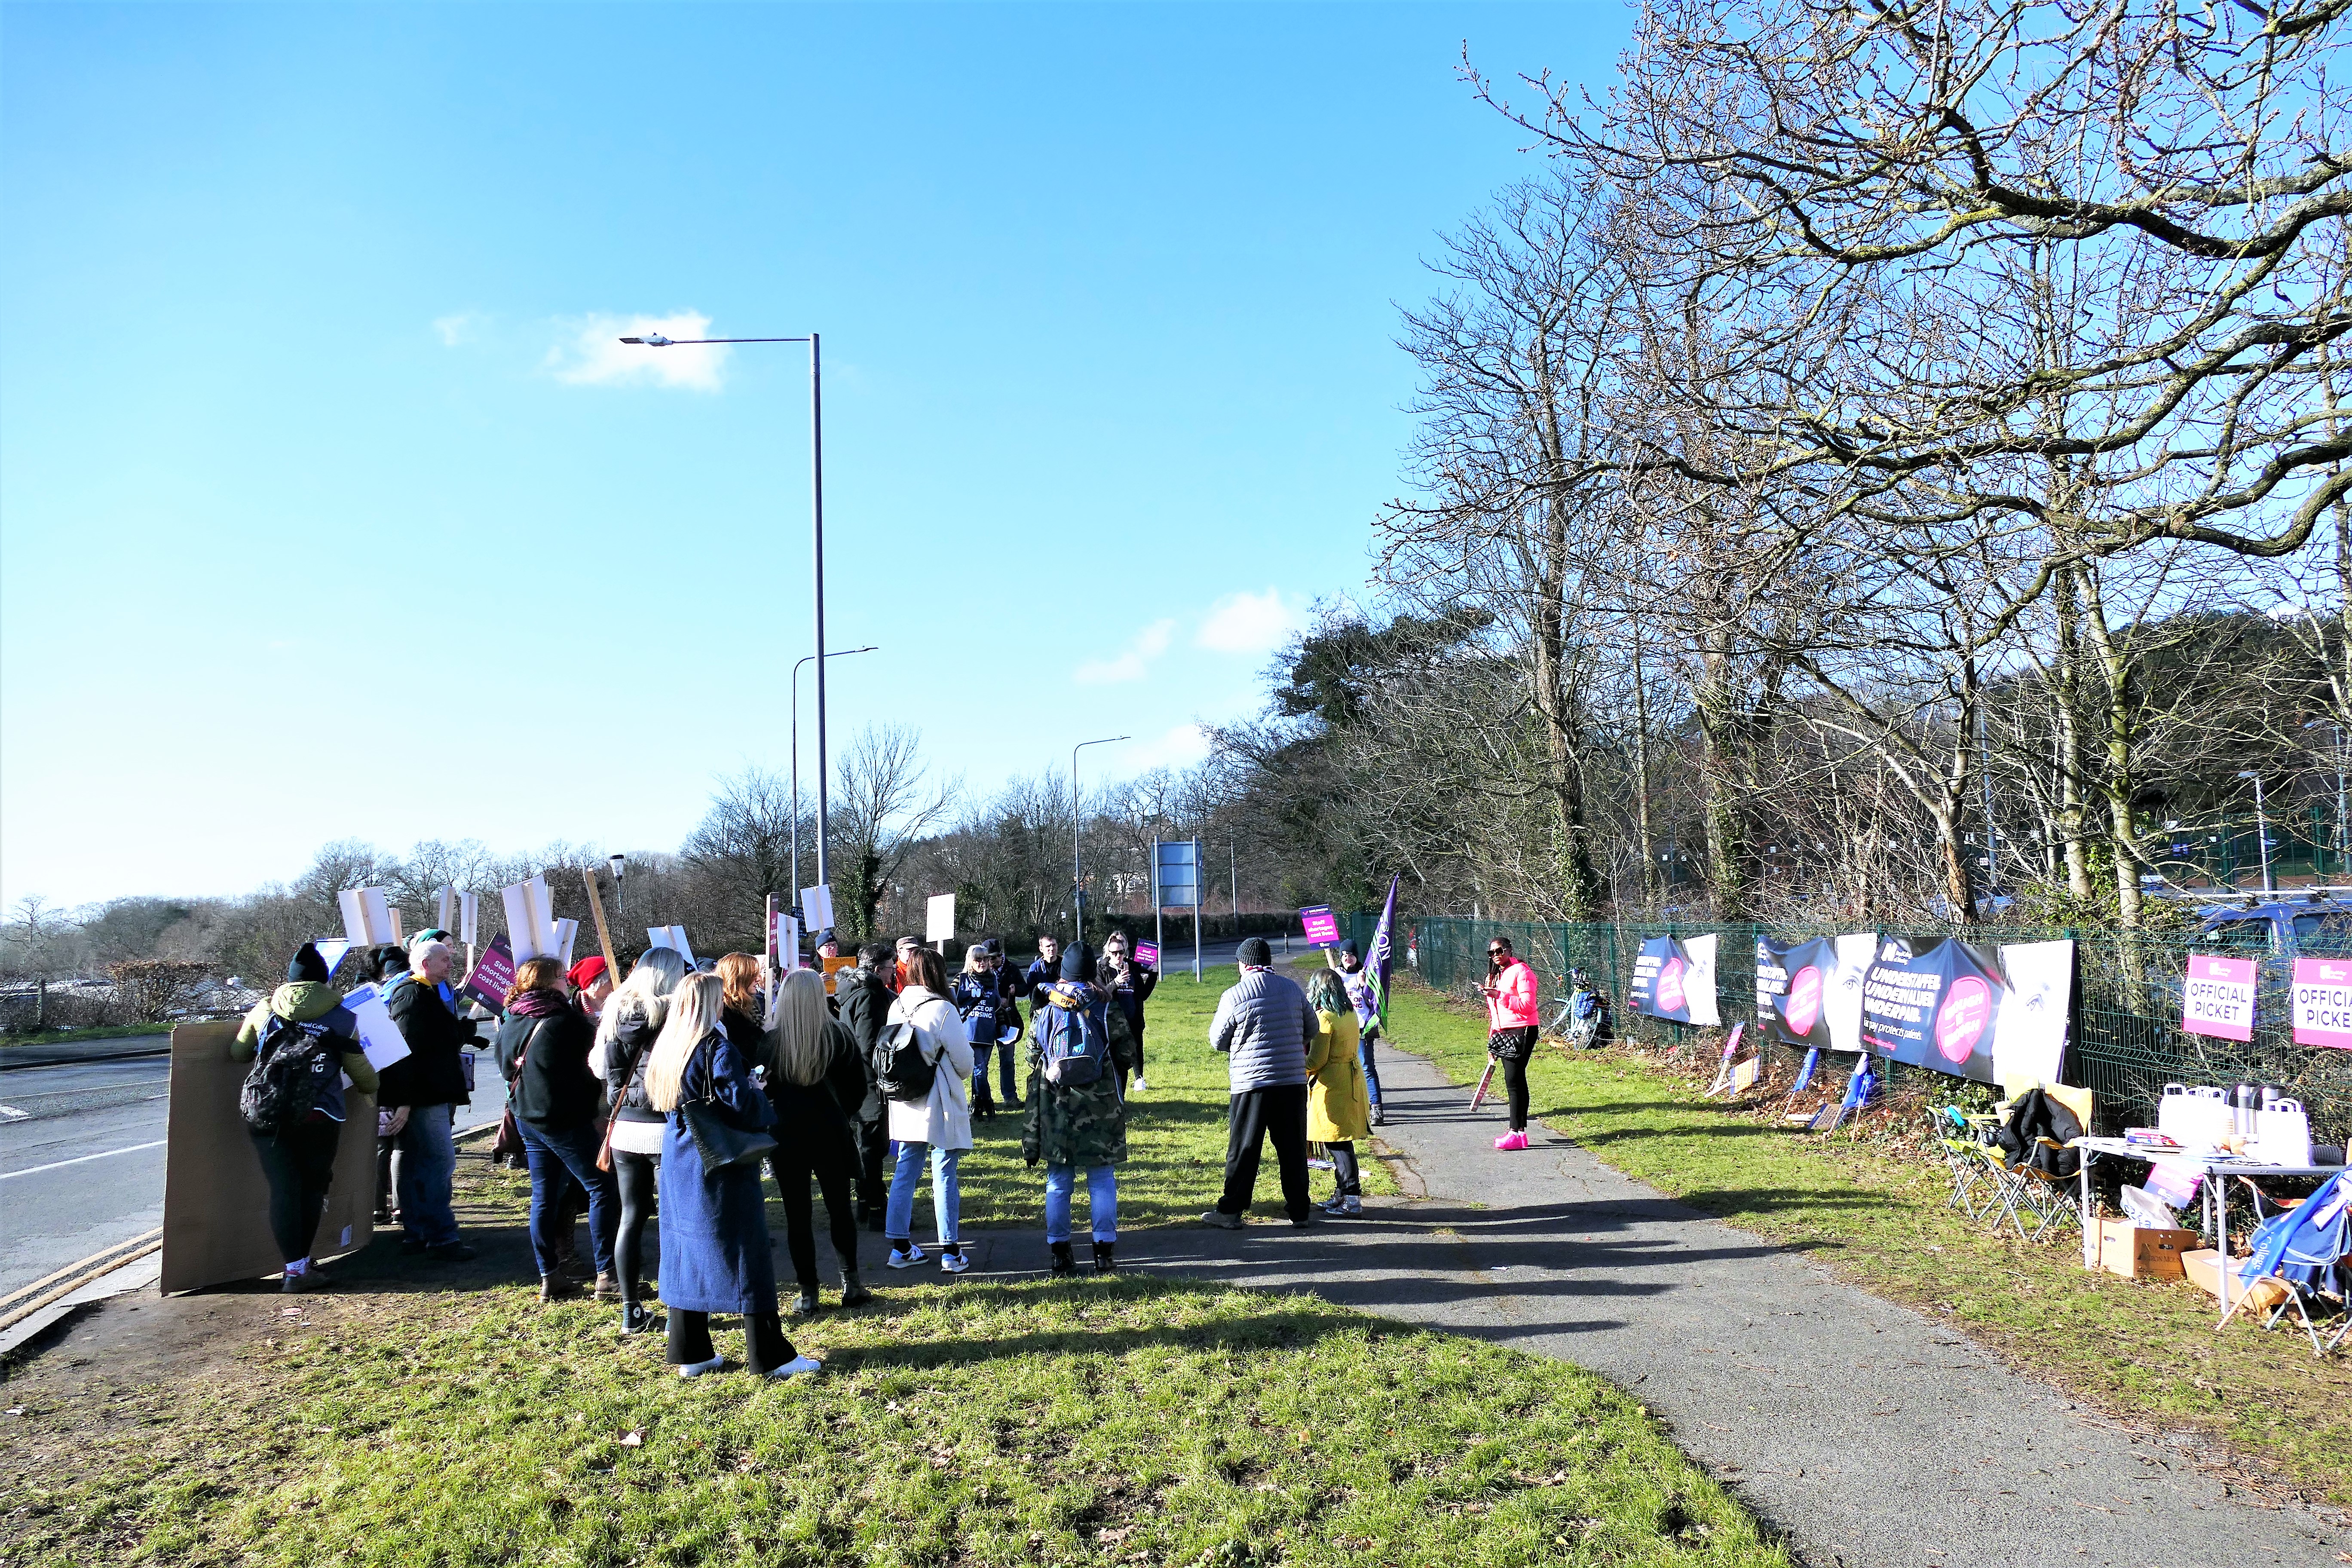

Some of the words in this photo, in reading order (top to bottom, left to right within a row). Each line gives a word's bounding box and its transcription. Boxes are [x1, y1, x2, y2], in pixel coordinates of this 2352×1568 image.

[494, 960, 512, 974] Staff
[478, 973, 493, 986] cost
[492, 982, 507, 995] lives
[2191, 983, 2247, 1003] OFFICIAL
[2195, 1001, 2239, 1020] PICKET
[2307, 1009, 2350, 1028] PICKE
[312, 1023, 330, 1032] College
[1877, 1023, 1905, 1037] protects
[2251, 1236, 2272, 1270] College
